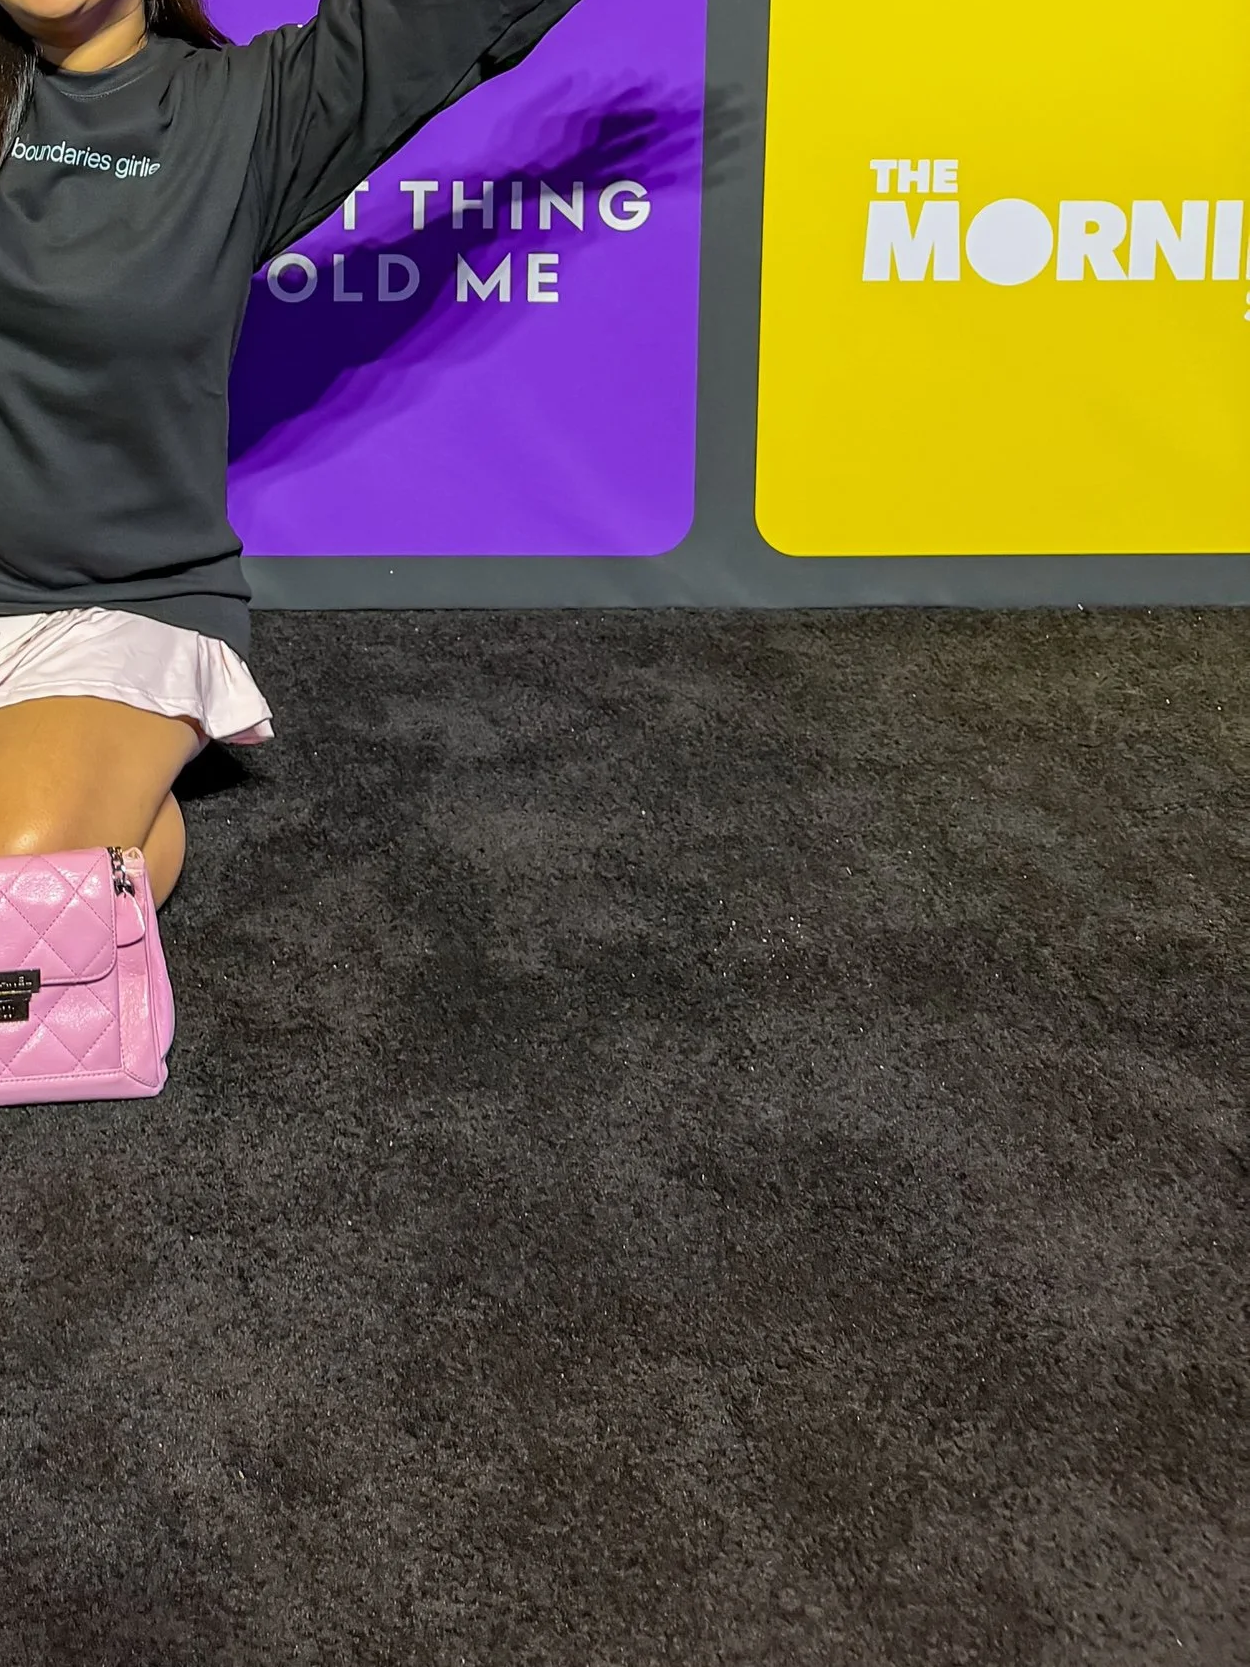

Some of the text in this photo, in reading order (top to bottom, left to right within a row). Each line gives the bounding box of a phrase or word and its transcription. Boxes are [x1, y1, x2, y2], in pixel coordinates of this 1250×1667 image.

[10, 137, 161, 179] boundaries girlie
[869, 159, 959, 194] THE
[399, 179, 652, 232] THING
[862, 197, 1250, 287] MORNI
[455, 251, 560, 303] ME
